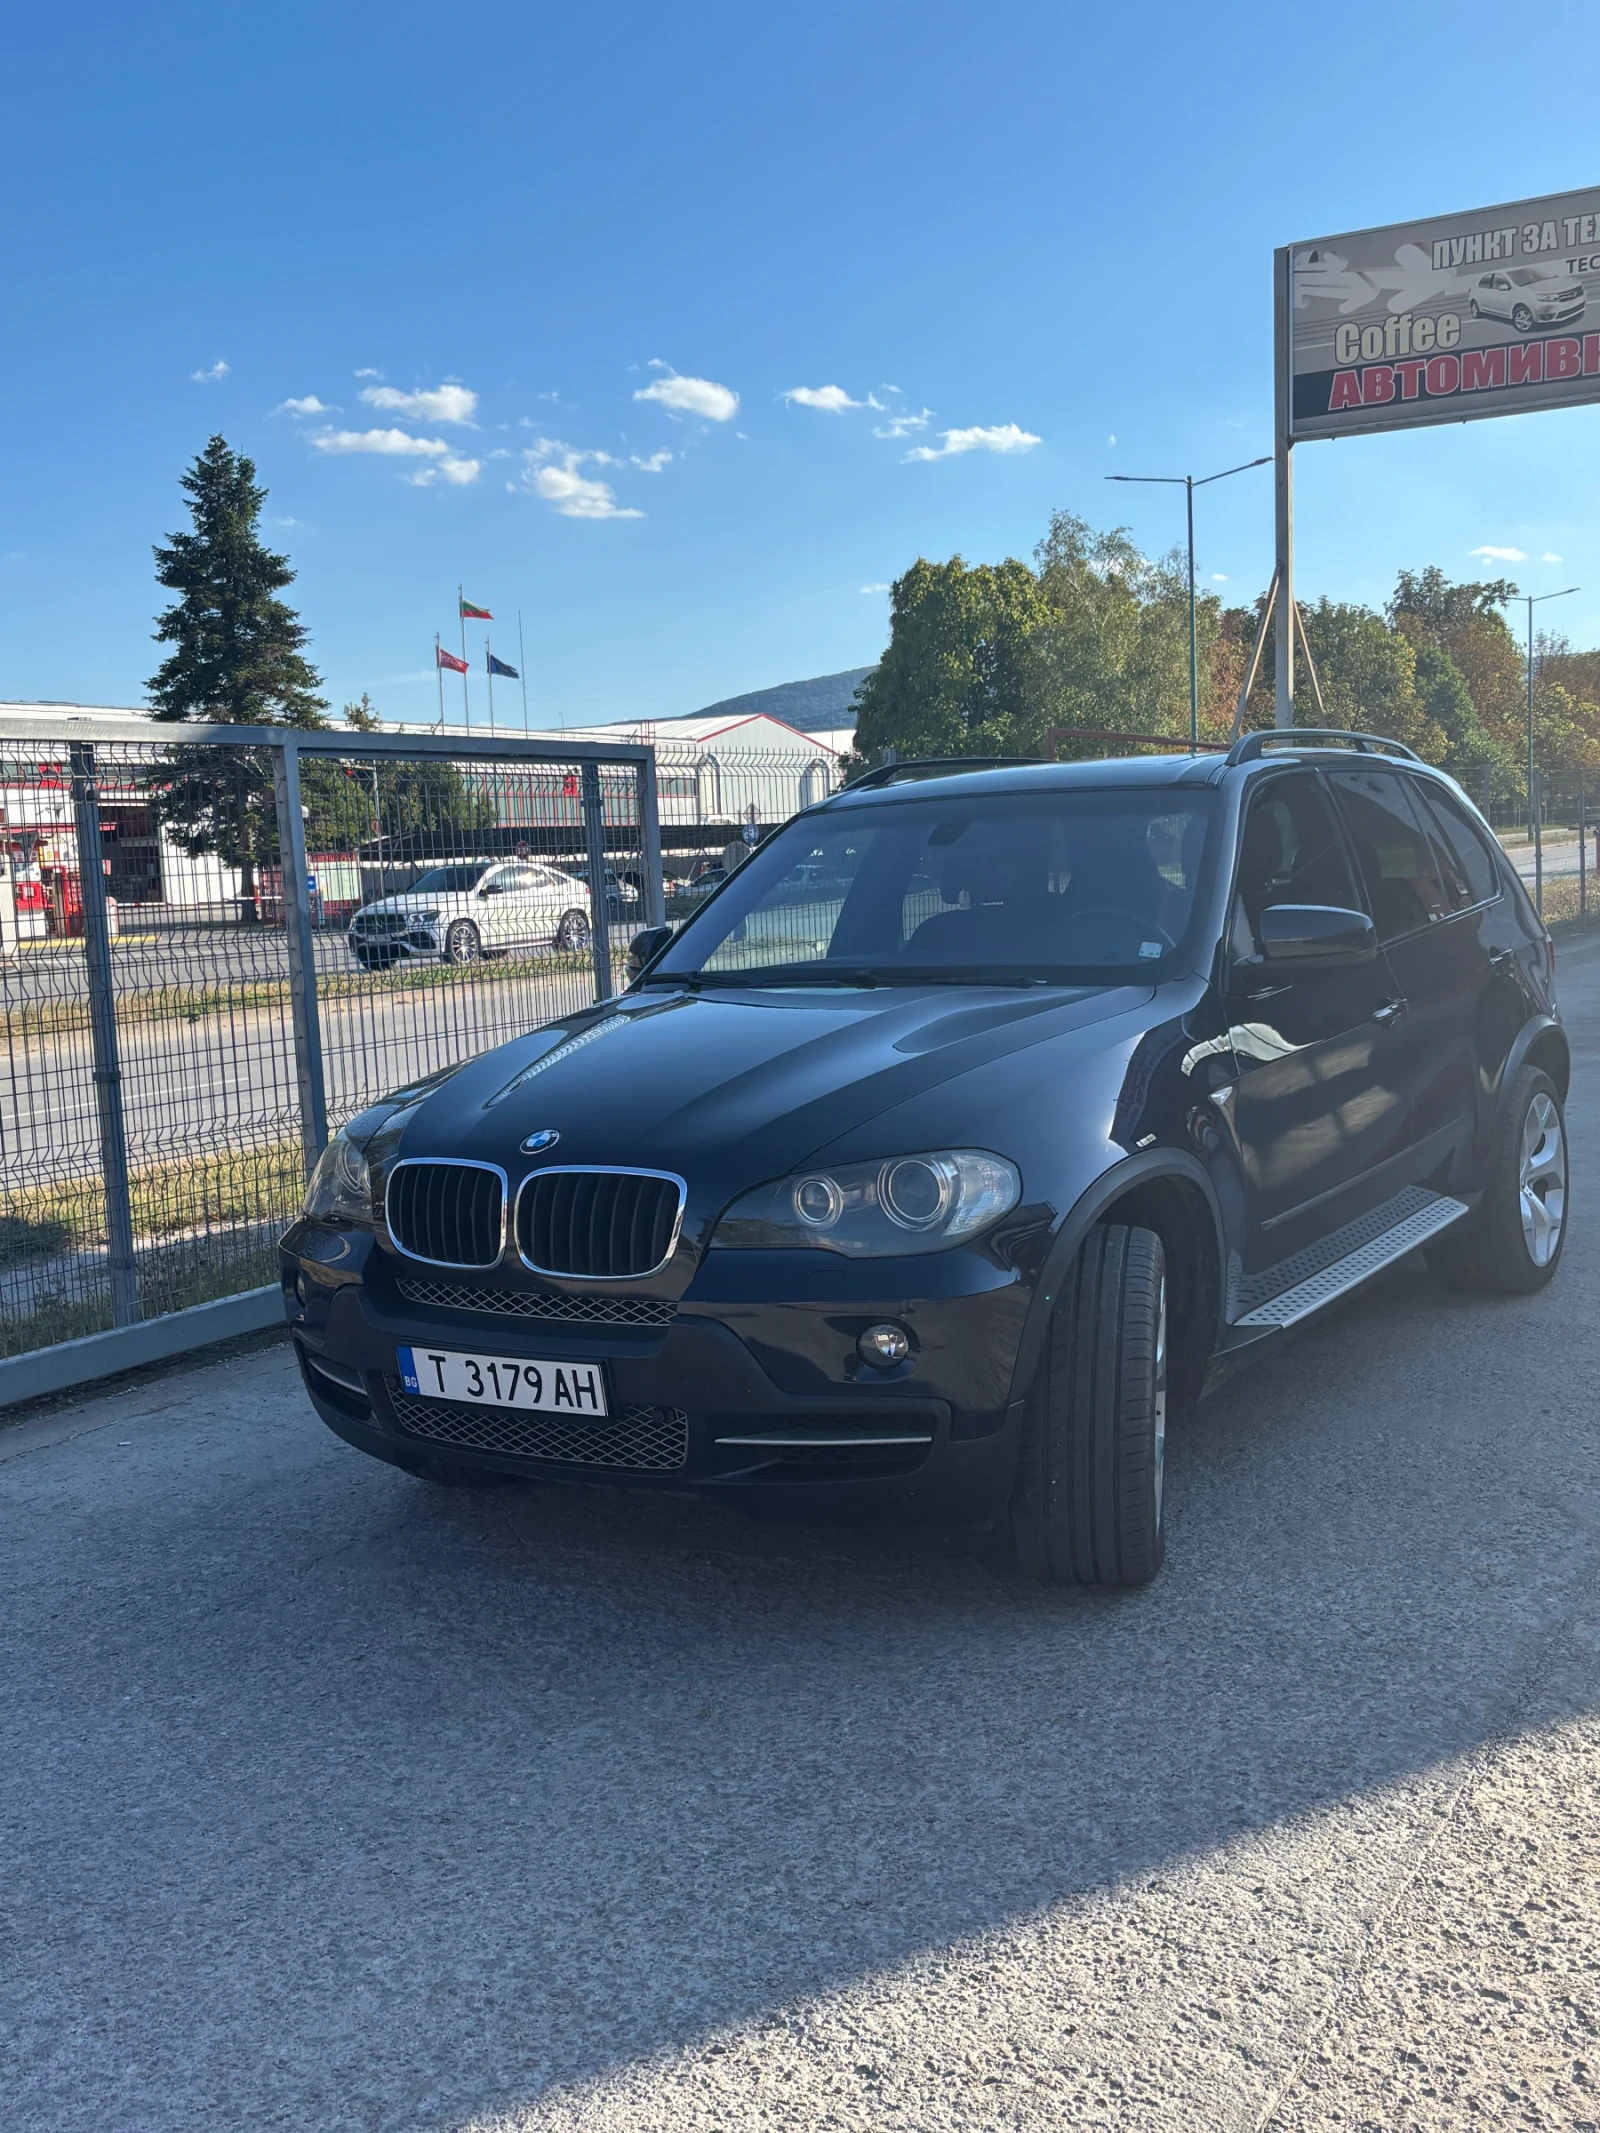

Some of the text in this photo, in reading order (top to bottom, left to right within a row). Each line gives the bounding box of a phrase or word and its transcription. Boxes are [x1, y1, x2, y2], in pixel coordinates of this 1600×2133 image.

[1432, 226, 1518, 271] ПУНКТ
[1522, 220, 1559, 254] ЗА
[1566, 254, 1600, 274] ТЕС
[1335, 312, 1461, 365] Coffee
[404, 1375, 418, 1388] BG
[428, 1354, 598, 1410] T 3179 AH
